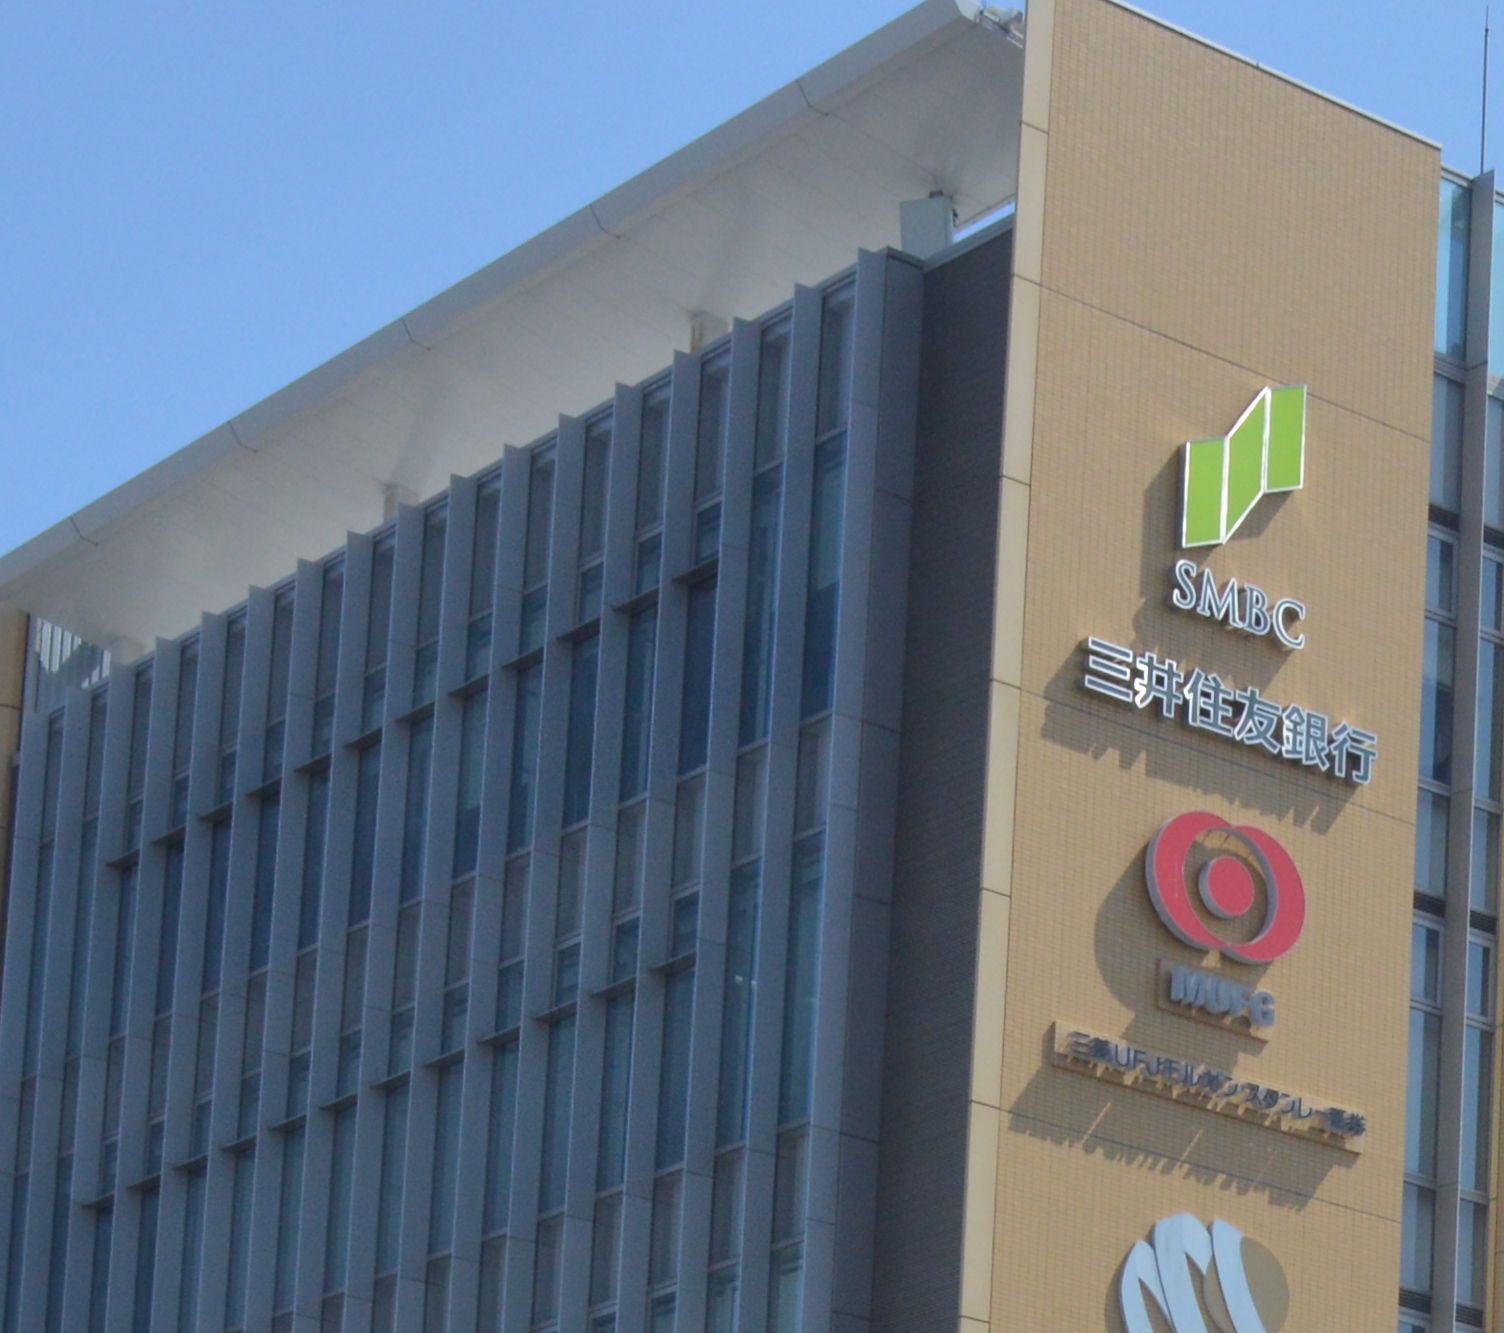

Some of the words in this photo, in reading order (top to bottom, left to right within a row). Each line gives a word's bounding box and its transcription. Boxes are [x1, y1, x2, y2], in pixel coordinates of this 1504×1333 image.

[1172, 558, 1306, 649] SMBC
[1084, 635, 1378, 785] 三井住友銀行
[1170, 965, 1275, 1027] MUFG
